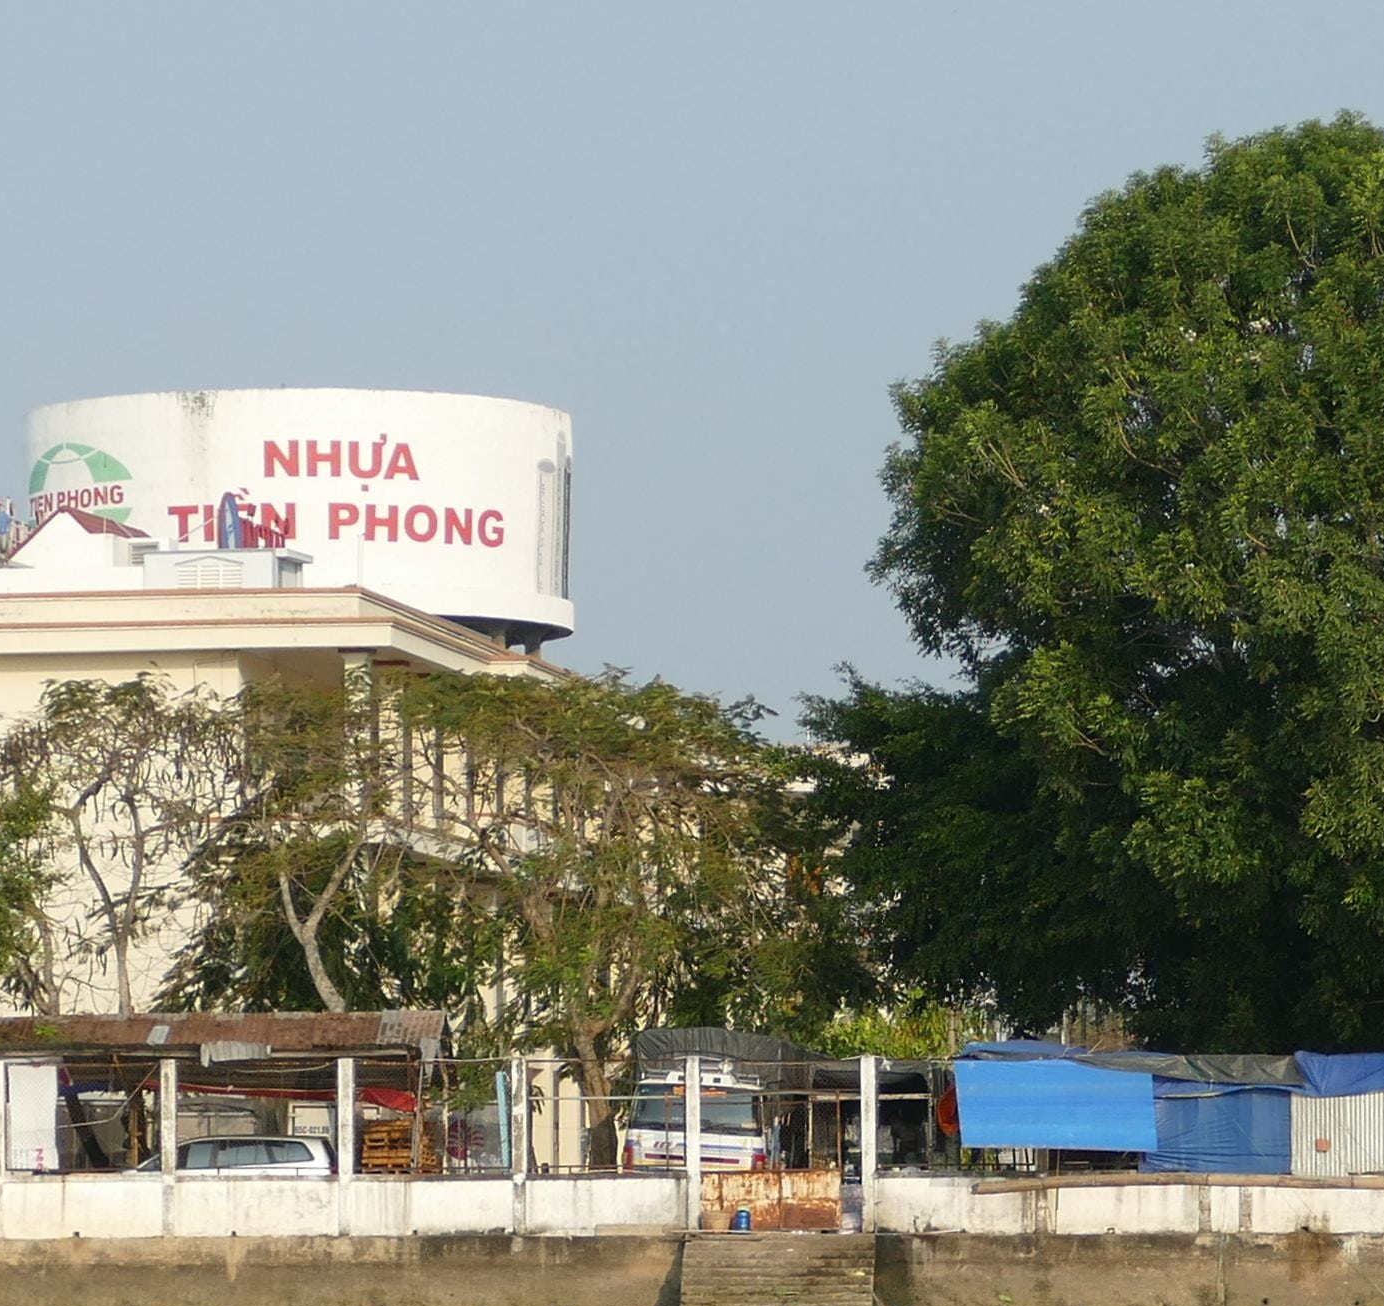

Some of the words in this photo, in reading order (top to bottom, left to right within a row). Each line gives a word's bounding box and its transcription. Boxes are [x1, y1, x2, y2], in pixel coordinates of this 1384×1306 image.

[263, 433, 420, 492] NHỰA
[57, 485, 124, 510] PHONG
[167, 487, 297, 543] TIN
[328, 502, 504, 548] PHONG
